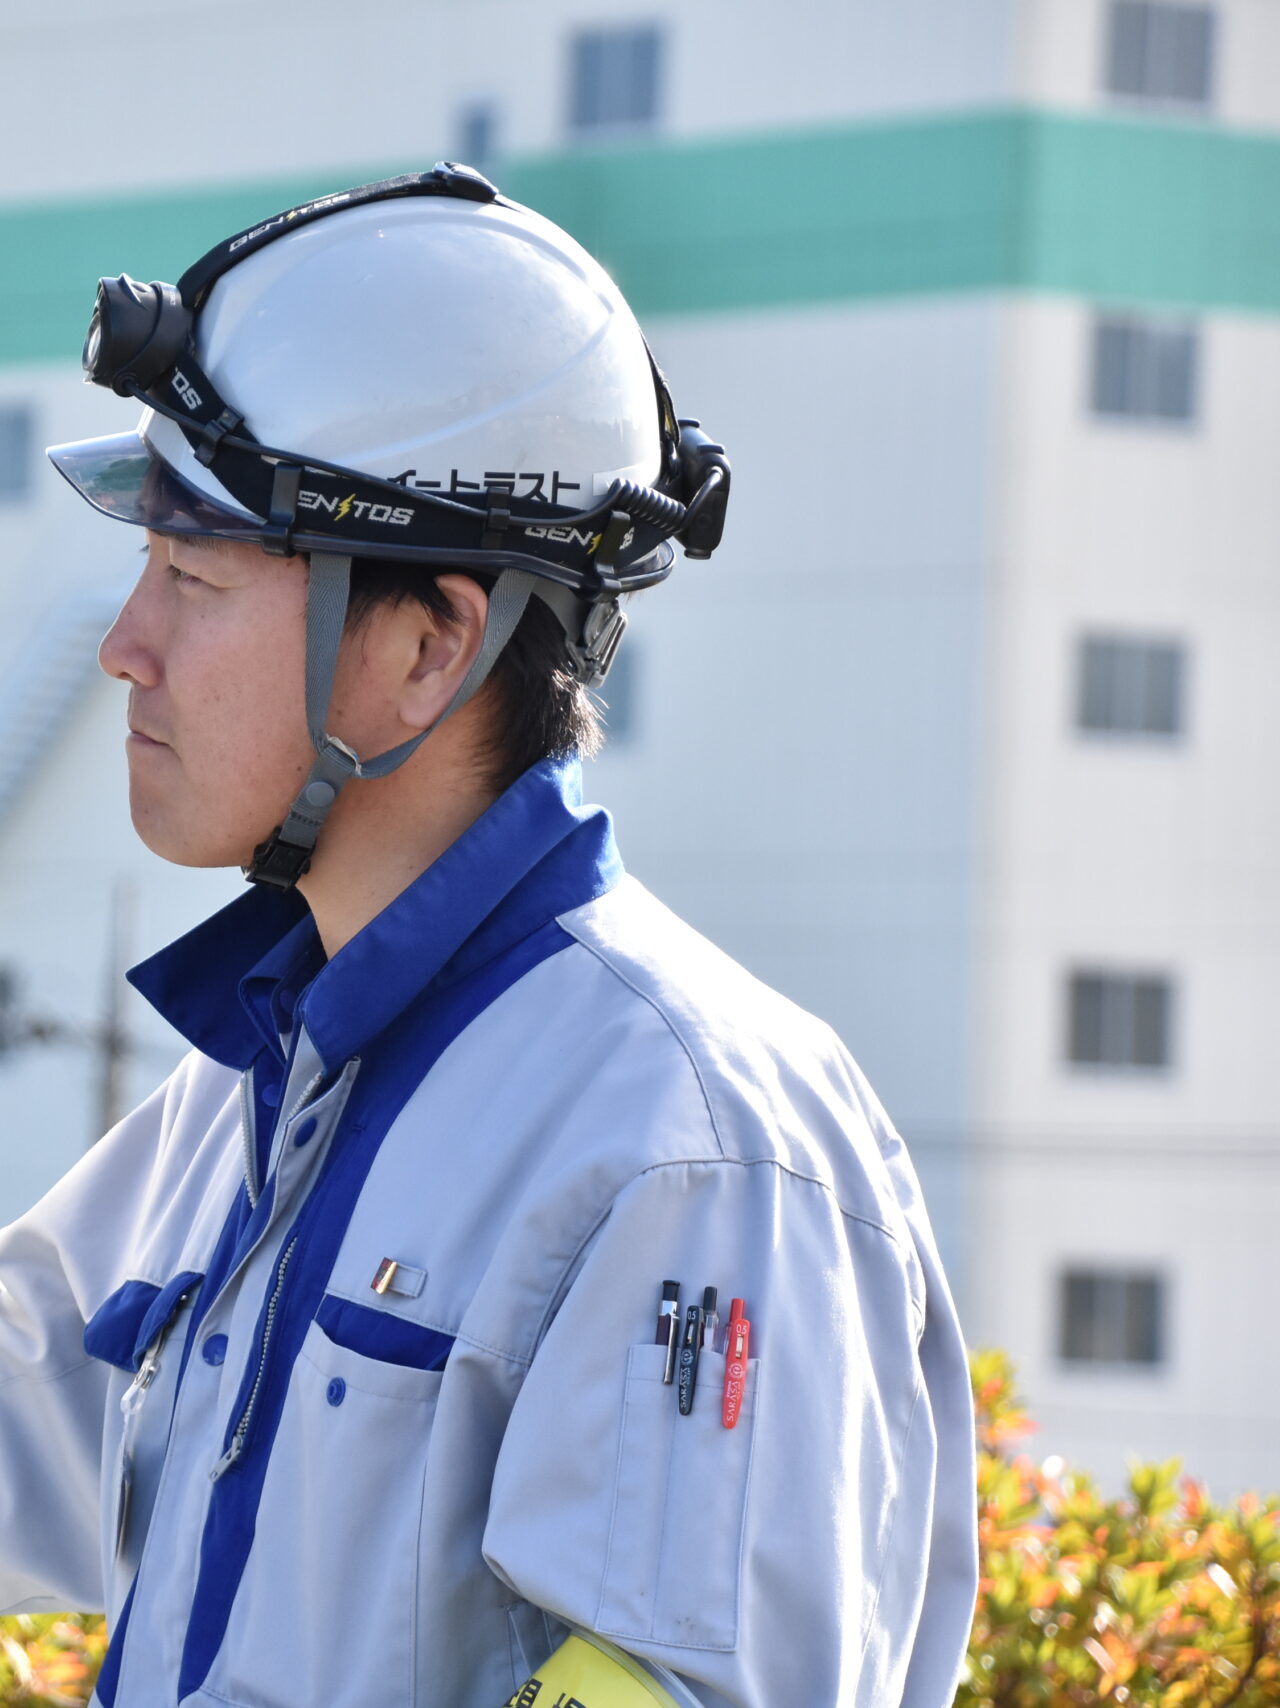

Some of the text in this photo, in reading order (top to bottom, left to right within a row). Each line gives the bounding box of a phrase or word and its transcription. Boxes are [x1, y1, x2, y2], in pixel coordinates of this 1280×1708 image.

[687, 1311, 696, 1321] 0.5
[736, 1324, 747, 1335] 0.5
[680, 1367, 689, 1410] SARASA
[727, 1380, 740, 1421] SARASA
